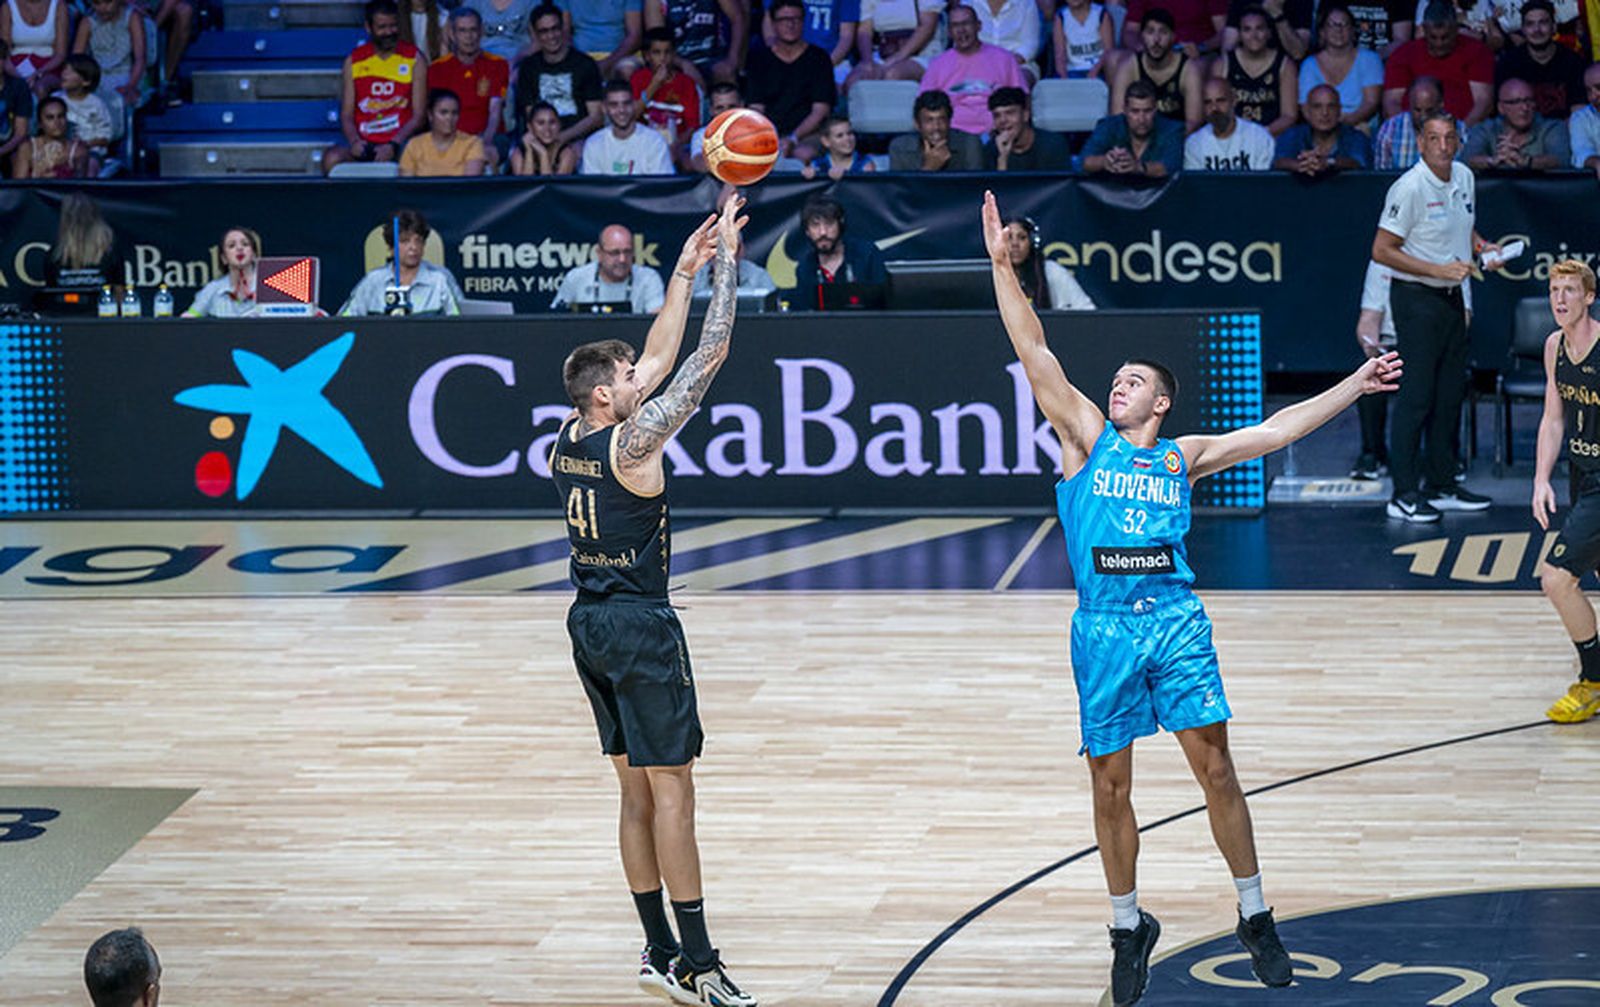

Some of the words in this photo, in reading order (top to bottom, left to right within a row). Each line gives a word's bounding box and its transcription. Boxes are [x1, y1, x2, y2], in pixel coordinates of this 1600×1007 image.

[459, 234, 661, 268] finetwk
[1043, 229, 1282, 283] endesa
[464, 276, 518, 293] FIBRA
[521, 277, 535, 292] Y
[1558, 382, 1600, 405] SPAÑA
[407, 354, 1064, 479] CaaBank
[1093, 468, 1181, 507] SLOVENIJA
[567, 487, 599, 540] 41
[1123, 508, 1147, 535] 32
[1100, 552, 1171, 569] telemach
